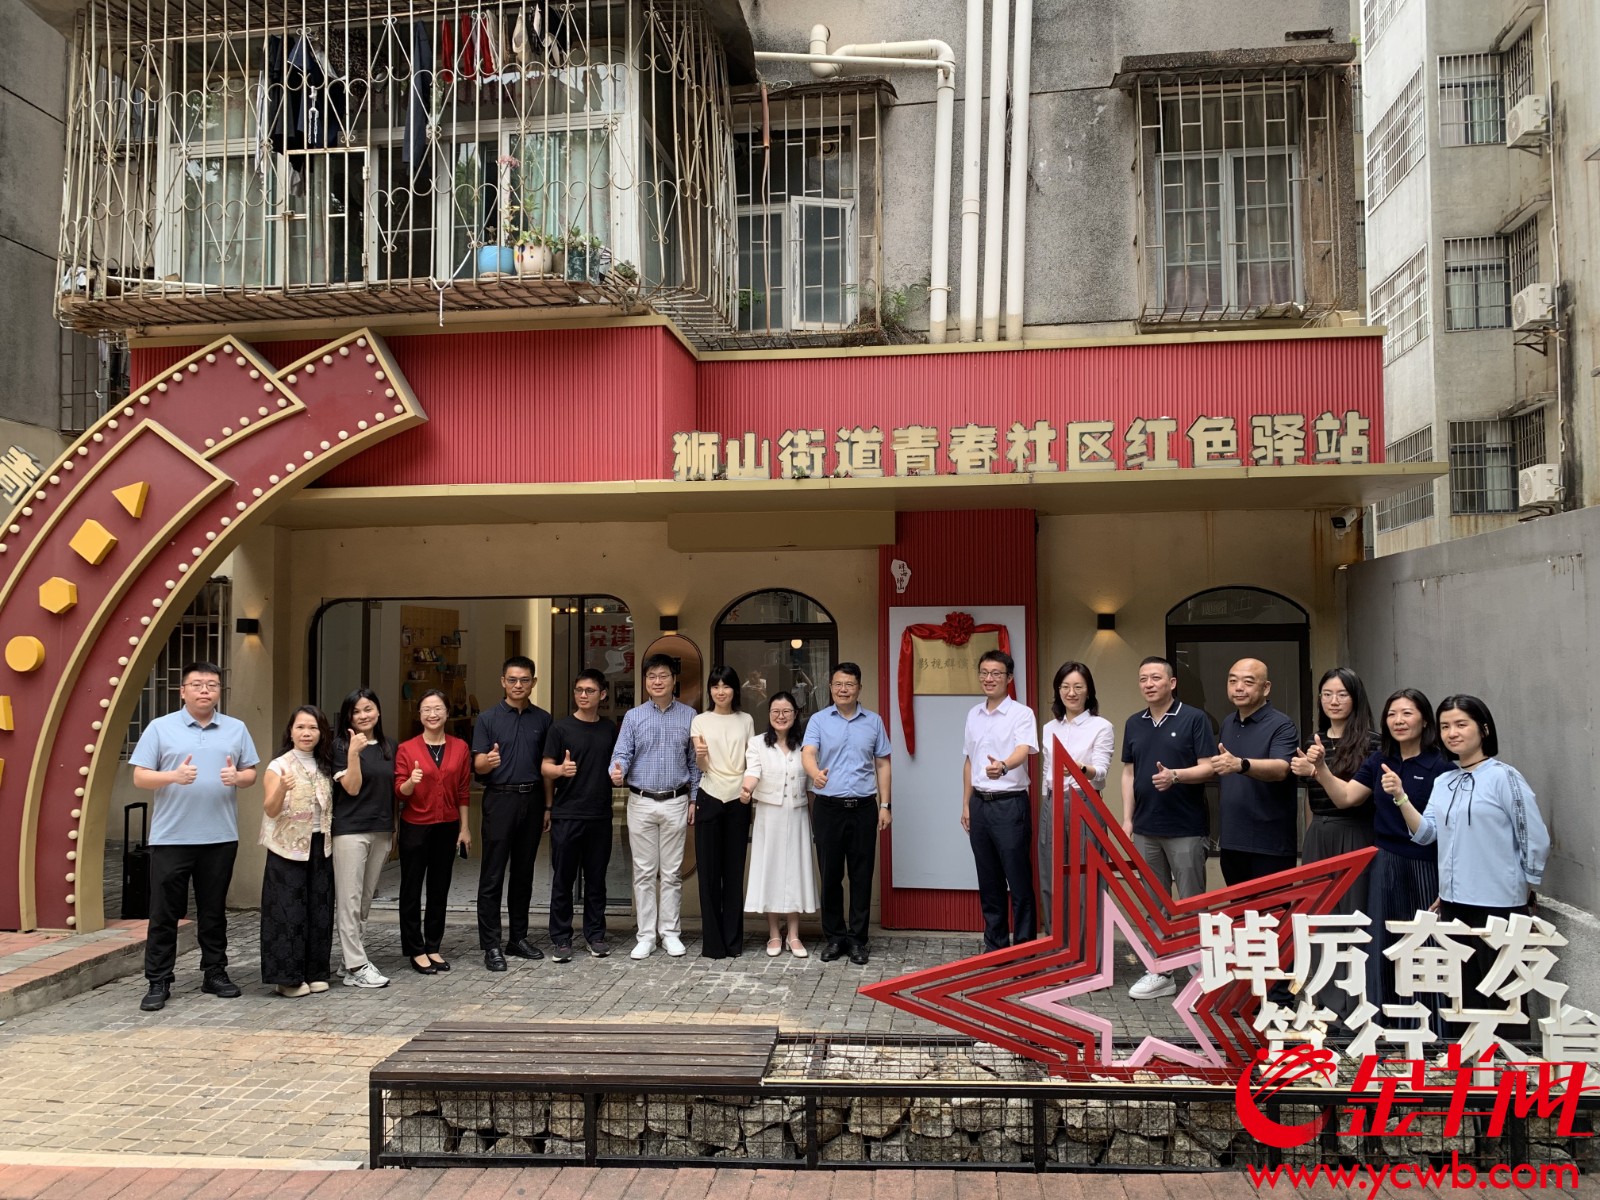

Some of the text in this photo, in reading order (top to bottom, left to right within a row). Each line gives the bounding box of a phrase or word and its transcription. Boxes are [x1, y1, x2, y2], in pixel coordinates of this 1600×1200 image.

[672, 410, 1370, 482] 狮山街道青春社区红色驿站
[1198, 909, 1569, 1001] 踔厉奋发
